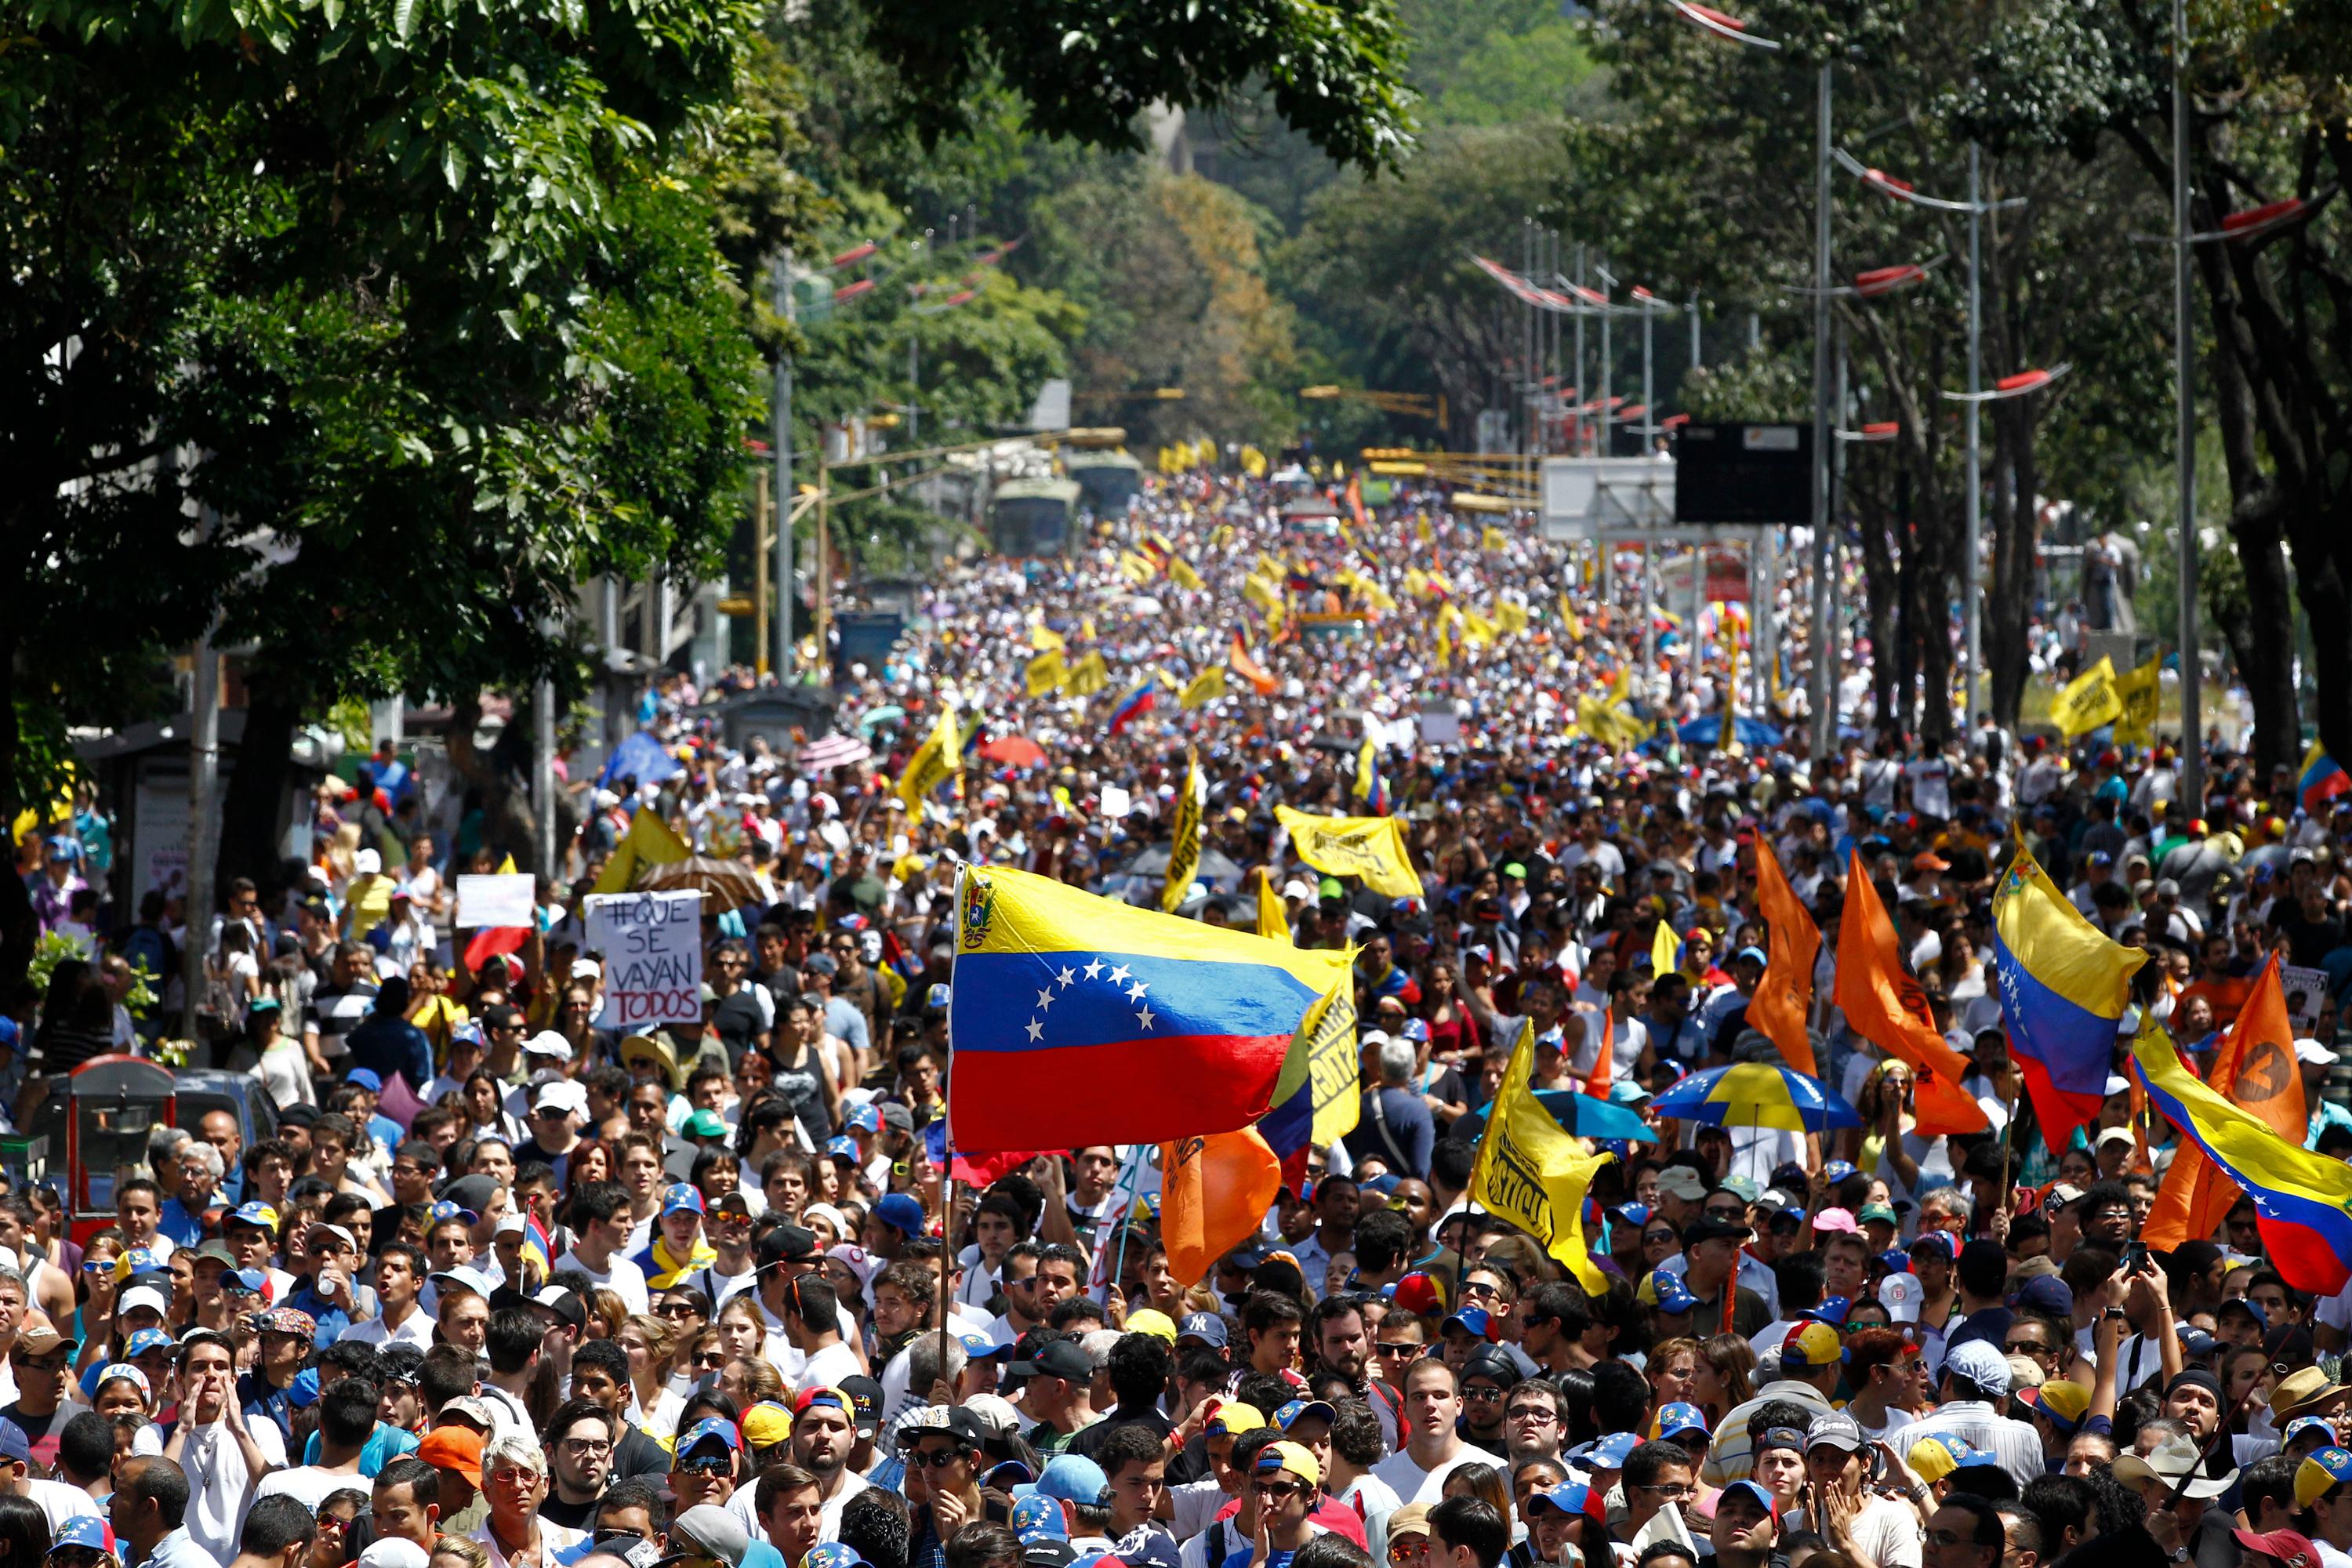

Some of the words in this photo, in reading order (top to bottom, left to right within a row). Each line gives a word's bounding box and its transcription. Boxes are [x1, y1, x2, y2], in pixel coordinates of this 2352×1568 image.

[606, 898, 690, 925] #QUE
[626, 927, 669, 954] SE
[612, 951, 691, 989] VAYAN
[612, 987, 699, 1024] TODOS
[1189, 1314, 1207, 1332] NY
[1809, 1420, 1853, 1439] Leones
